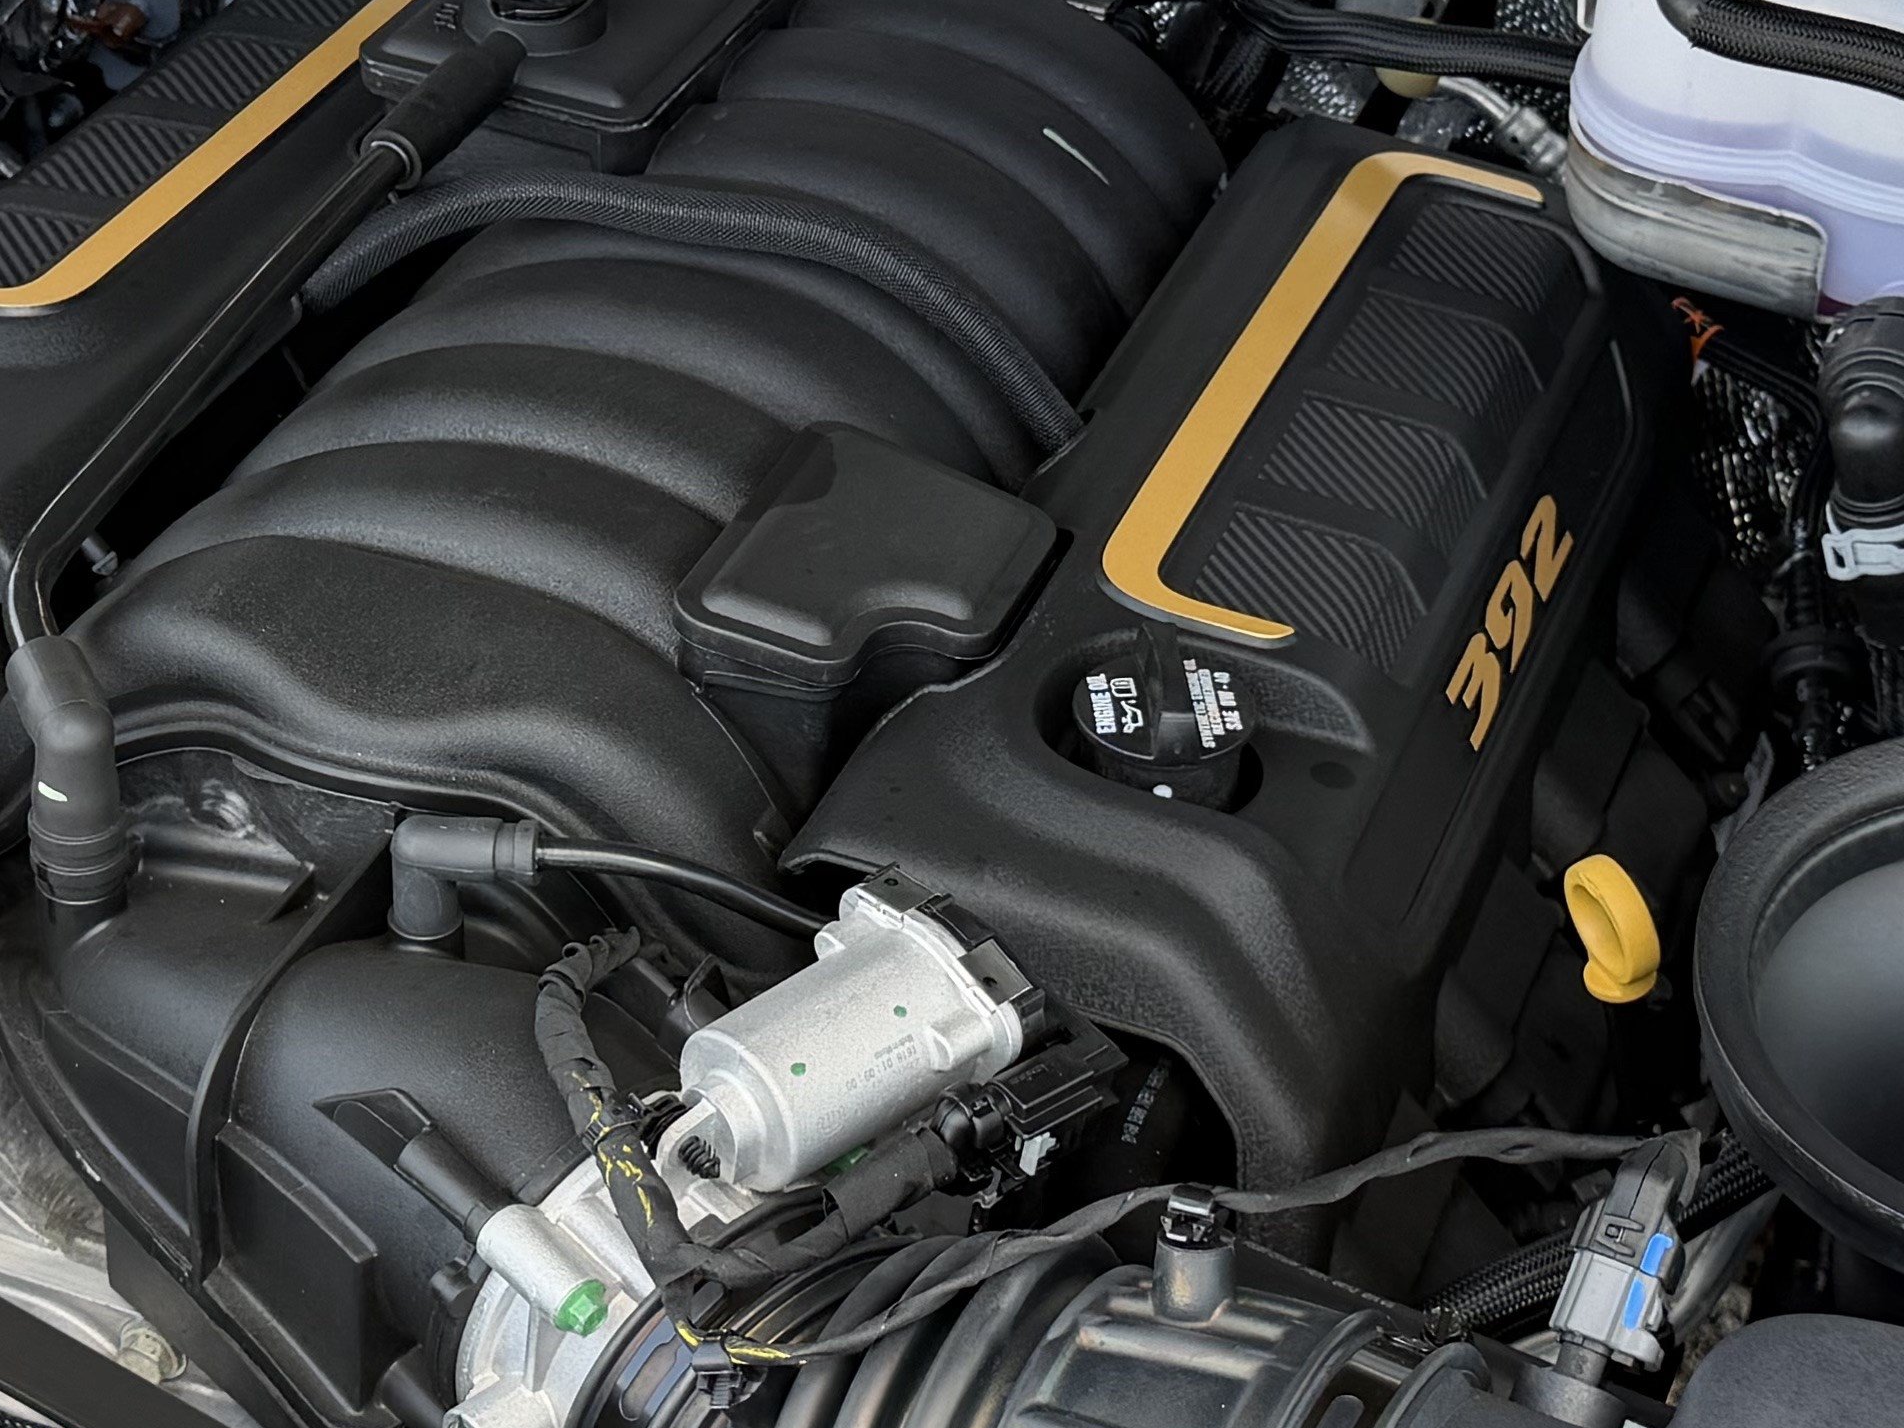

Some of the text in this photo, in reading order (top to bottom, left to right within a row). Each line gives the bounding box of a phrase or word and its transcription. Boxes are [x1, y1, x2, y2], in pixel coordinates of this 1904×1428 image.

[1446, 494, 1574, 752] 392
[1085, 673, 1118, 735] ENGINE OIL
[1221, 710, 1244, 731] SAE
